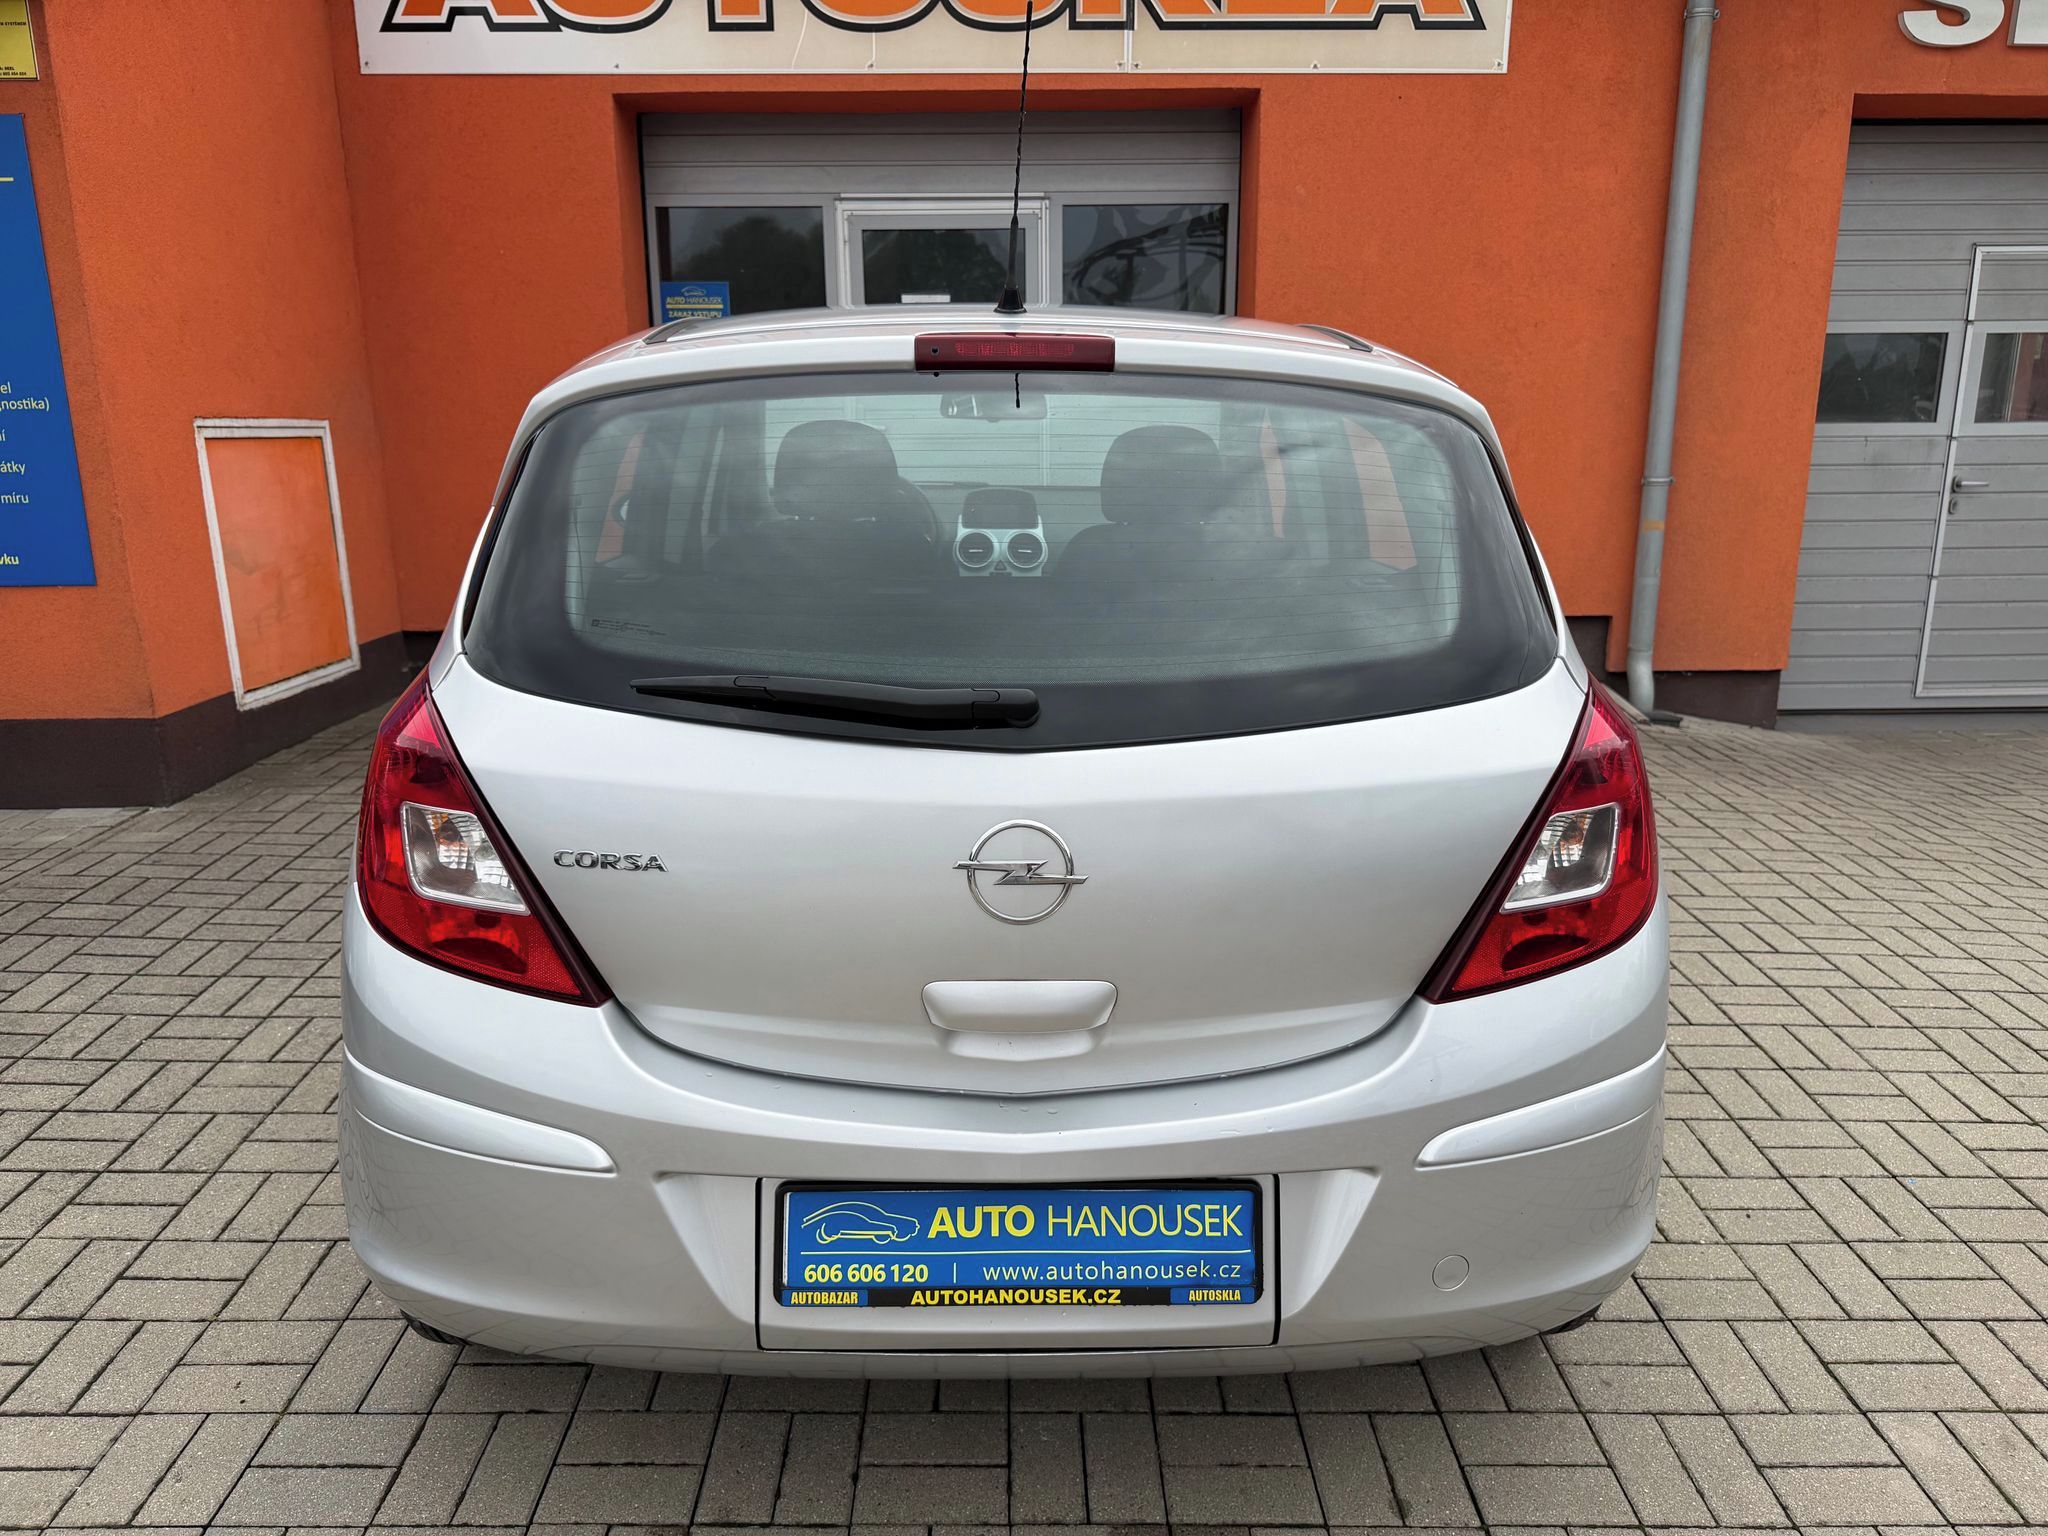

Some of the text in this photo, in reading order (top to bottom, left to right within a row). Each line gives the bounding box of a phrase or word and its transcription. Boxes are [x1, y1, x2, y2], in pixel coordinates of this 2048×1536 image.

[0, 397, 50, 412] nostika)
[0, 492, 29, 504] míru
[553, 849, 669, 872] CORSA
[927, 1204, 1243, 1238] AUTO HANOUSEK
[804, 1260, 1241, 1283] 606 606 120 www.autohanousek.cz
[791, 1291, 858, 1304] AUTOBAZAR
[911, 1288, 1121, 1305] AUTOHANOUSEK.CZ
[1188, 1289, 1241, 1301] AUTOSKLA
